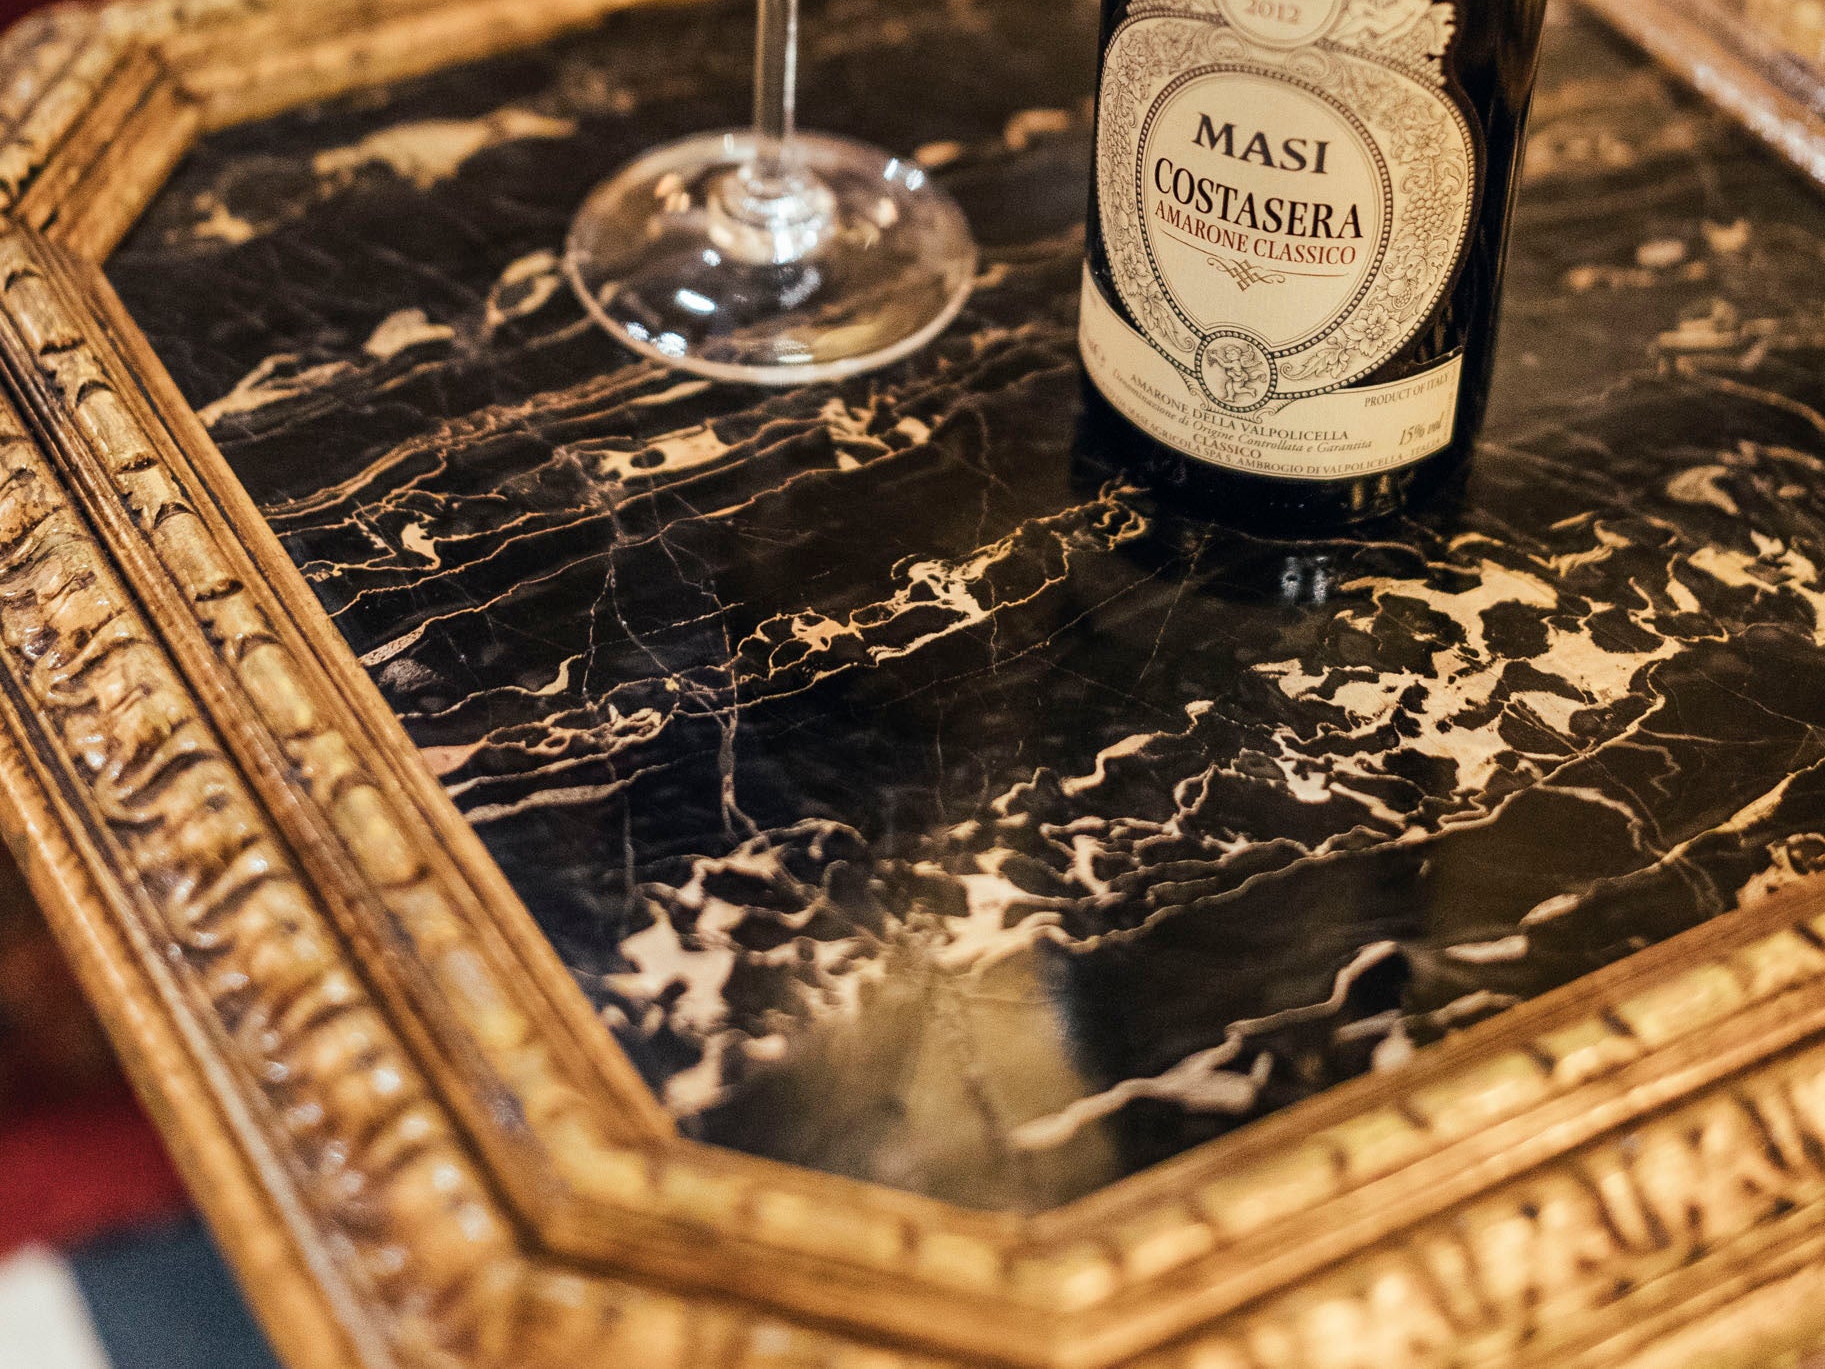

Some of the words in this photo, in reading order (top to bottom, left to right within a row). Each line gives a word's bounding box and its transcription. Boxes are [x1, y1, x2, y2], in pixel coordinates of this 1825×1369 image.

[1192, 111, 1330, 175] MASI
[1154, 157, 1364, 239] COSTASERA
[1155, 200, 1248, 253] AMARONE
[1253, 237, 1356, 265] CLASSICO
[1131, 374, 1190, 412] AMARONE
[1192, 408, 1236, 430] DELLA
[1241, 422, 1348, 441] VALPOLICELLA
[1364, 387, 1413, 408] PRODUCT
[1412, 381, 1427, 397] OF
[1425, 373, 1449, 391] ITALY
[1150, 422, 1201, 453] AGRICOLA
[1237, 457, 1304, 474] AMBROGIO
[1306, 464, 1321, 474] DI
[1323, 453, 1403, 474] VALPOLICELLA
[1178, 415, 1190, 427] di
[1192, 420, 1234, 442] Origine
[1238, 434, 1305, 452] Controllata
[1306, 445, 1314, 453] e
[1316, 440, 1373, 452] Garantita
[1192, 433, 1262, 459] CLASSICO
[1399, 423, 1426, 446] 15%
